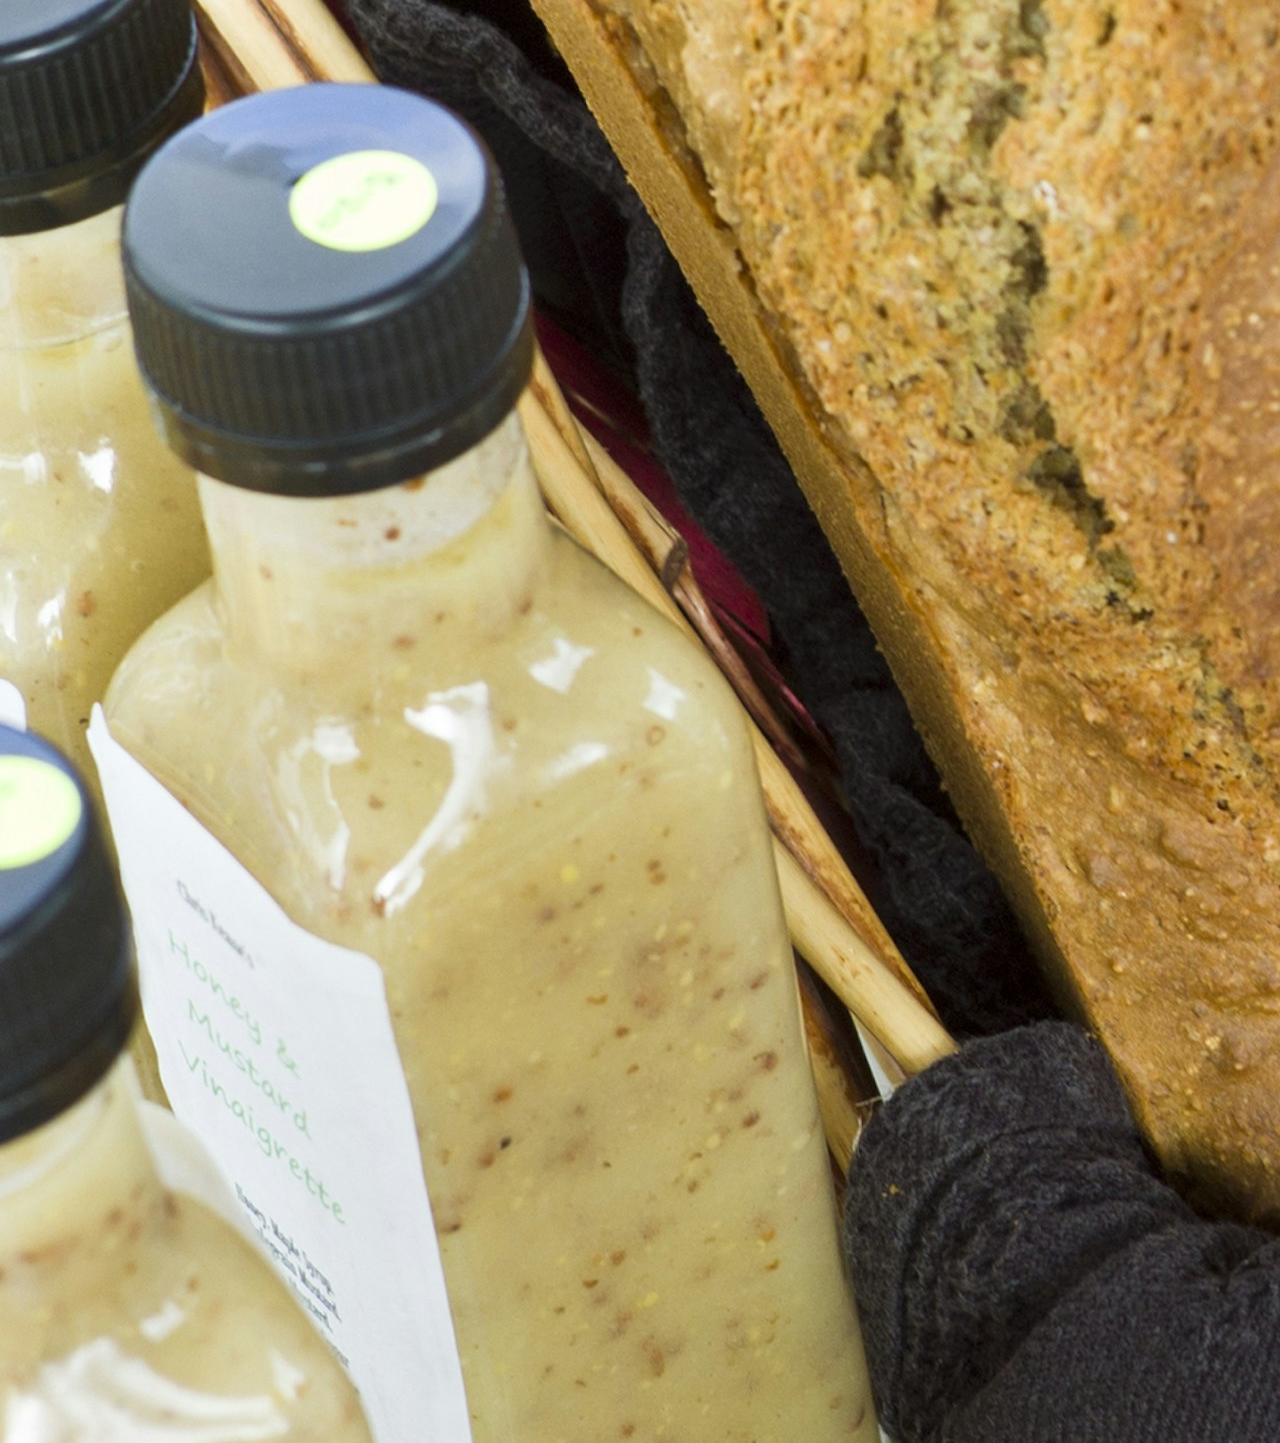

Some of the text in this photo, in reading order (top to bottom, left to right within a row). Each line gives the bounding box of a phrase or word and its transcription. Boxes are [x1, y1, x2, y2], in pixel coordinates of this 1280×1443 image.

[168, 928, 302, 1081] Honey &
[188, 999, 312, 1141] Mustard
[178, 1038, 346, 1226] Vinaigrette
